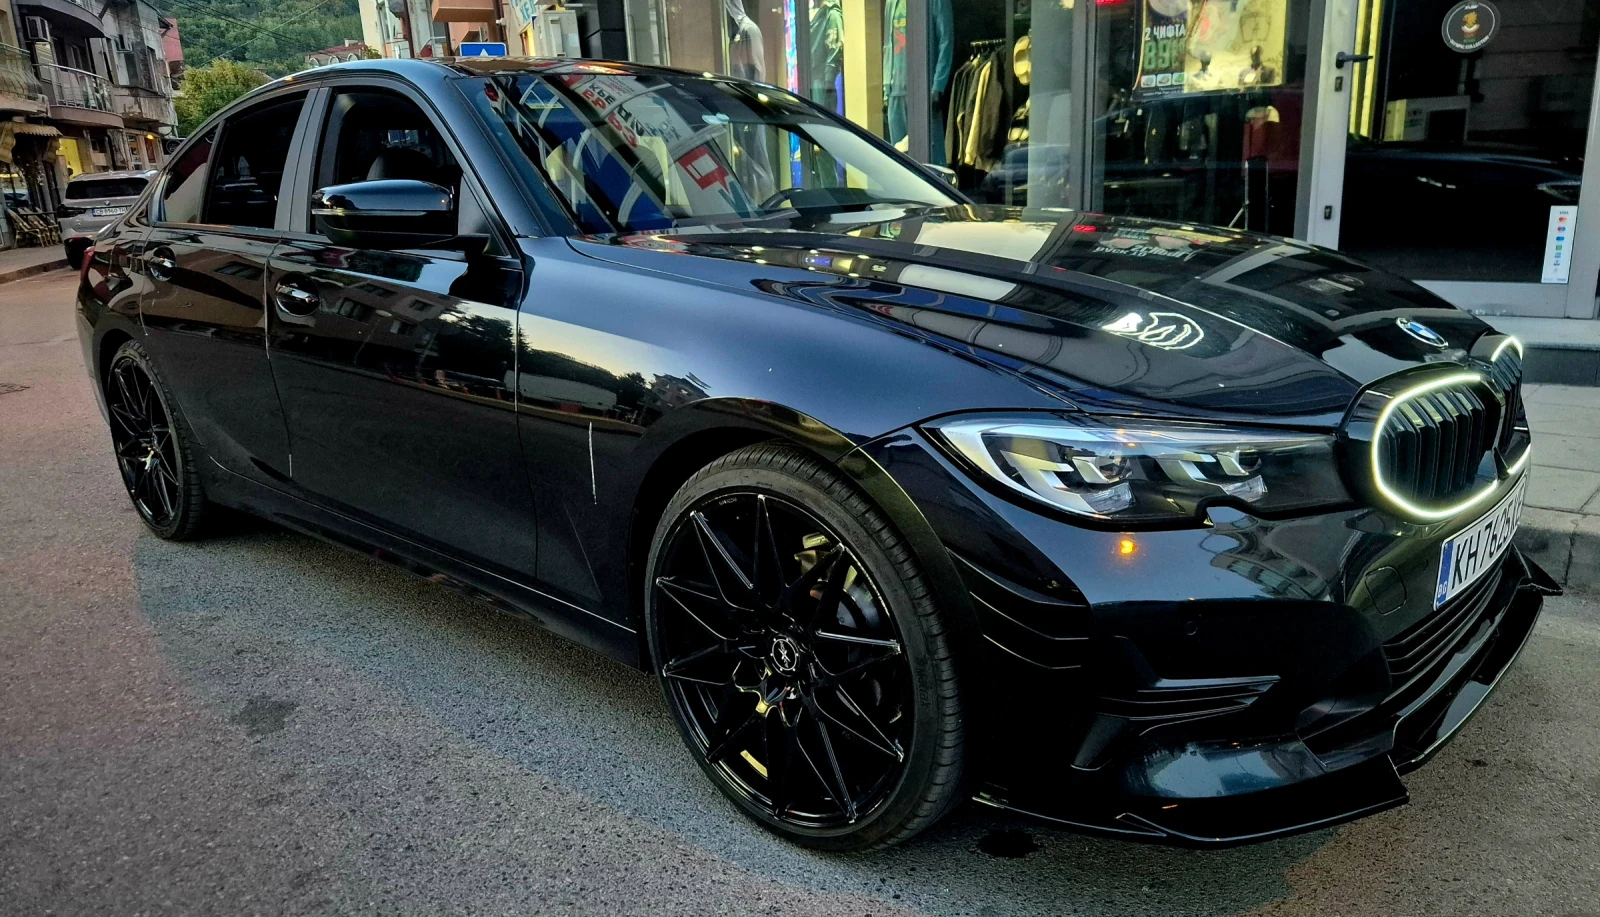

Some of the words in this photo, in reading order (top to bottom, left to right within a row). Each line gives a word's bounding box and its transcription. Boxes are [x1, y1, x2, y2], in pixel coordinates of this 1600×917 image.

[1144, 27, 1152, 41] 2
[1153, 23, 1187, 39] ЧИФТА
[1452, 530, 1481, 590] KH
[1437, 581, 1448, 598] BG
